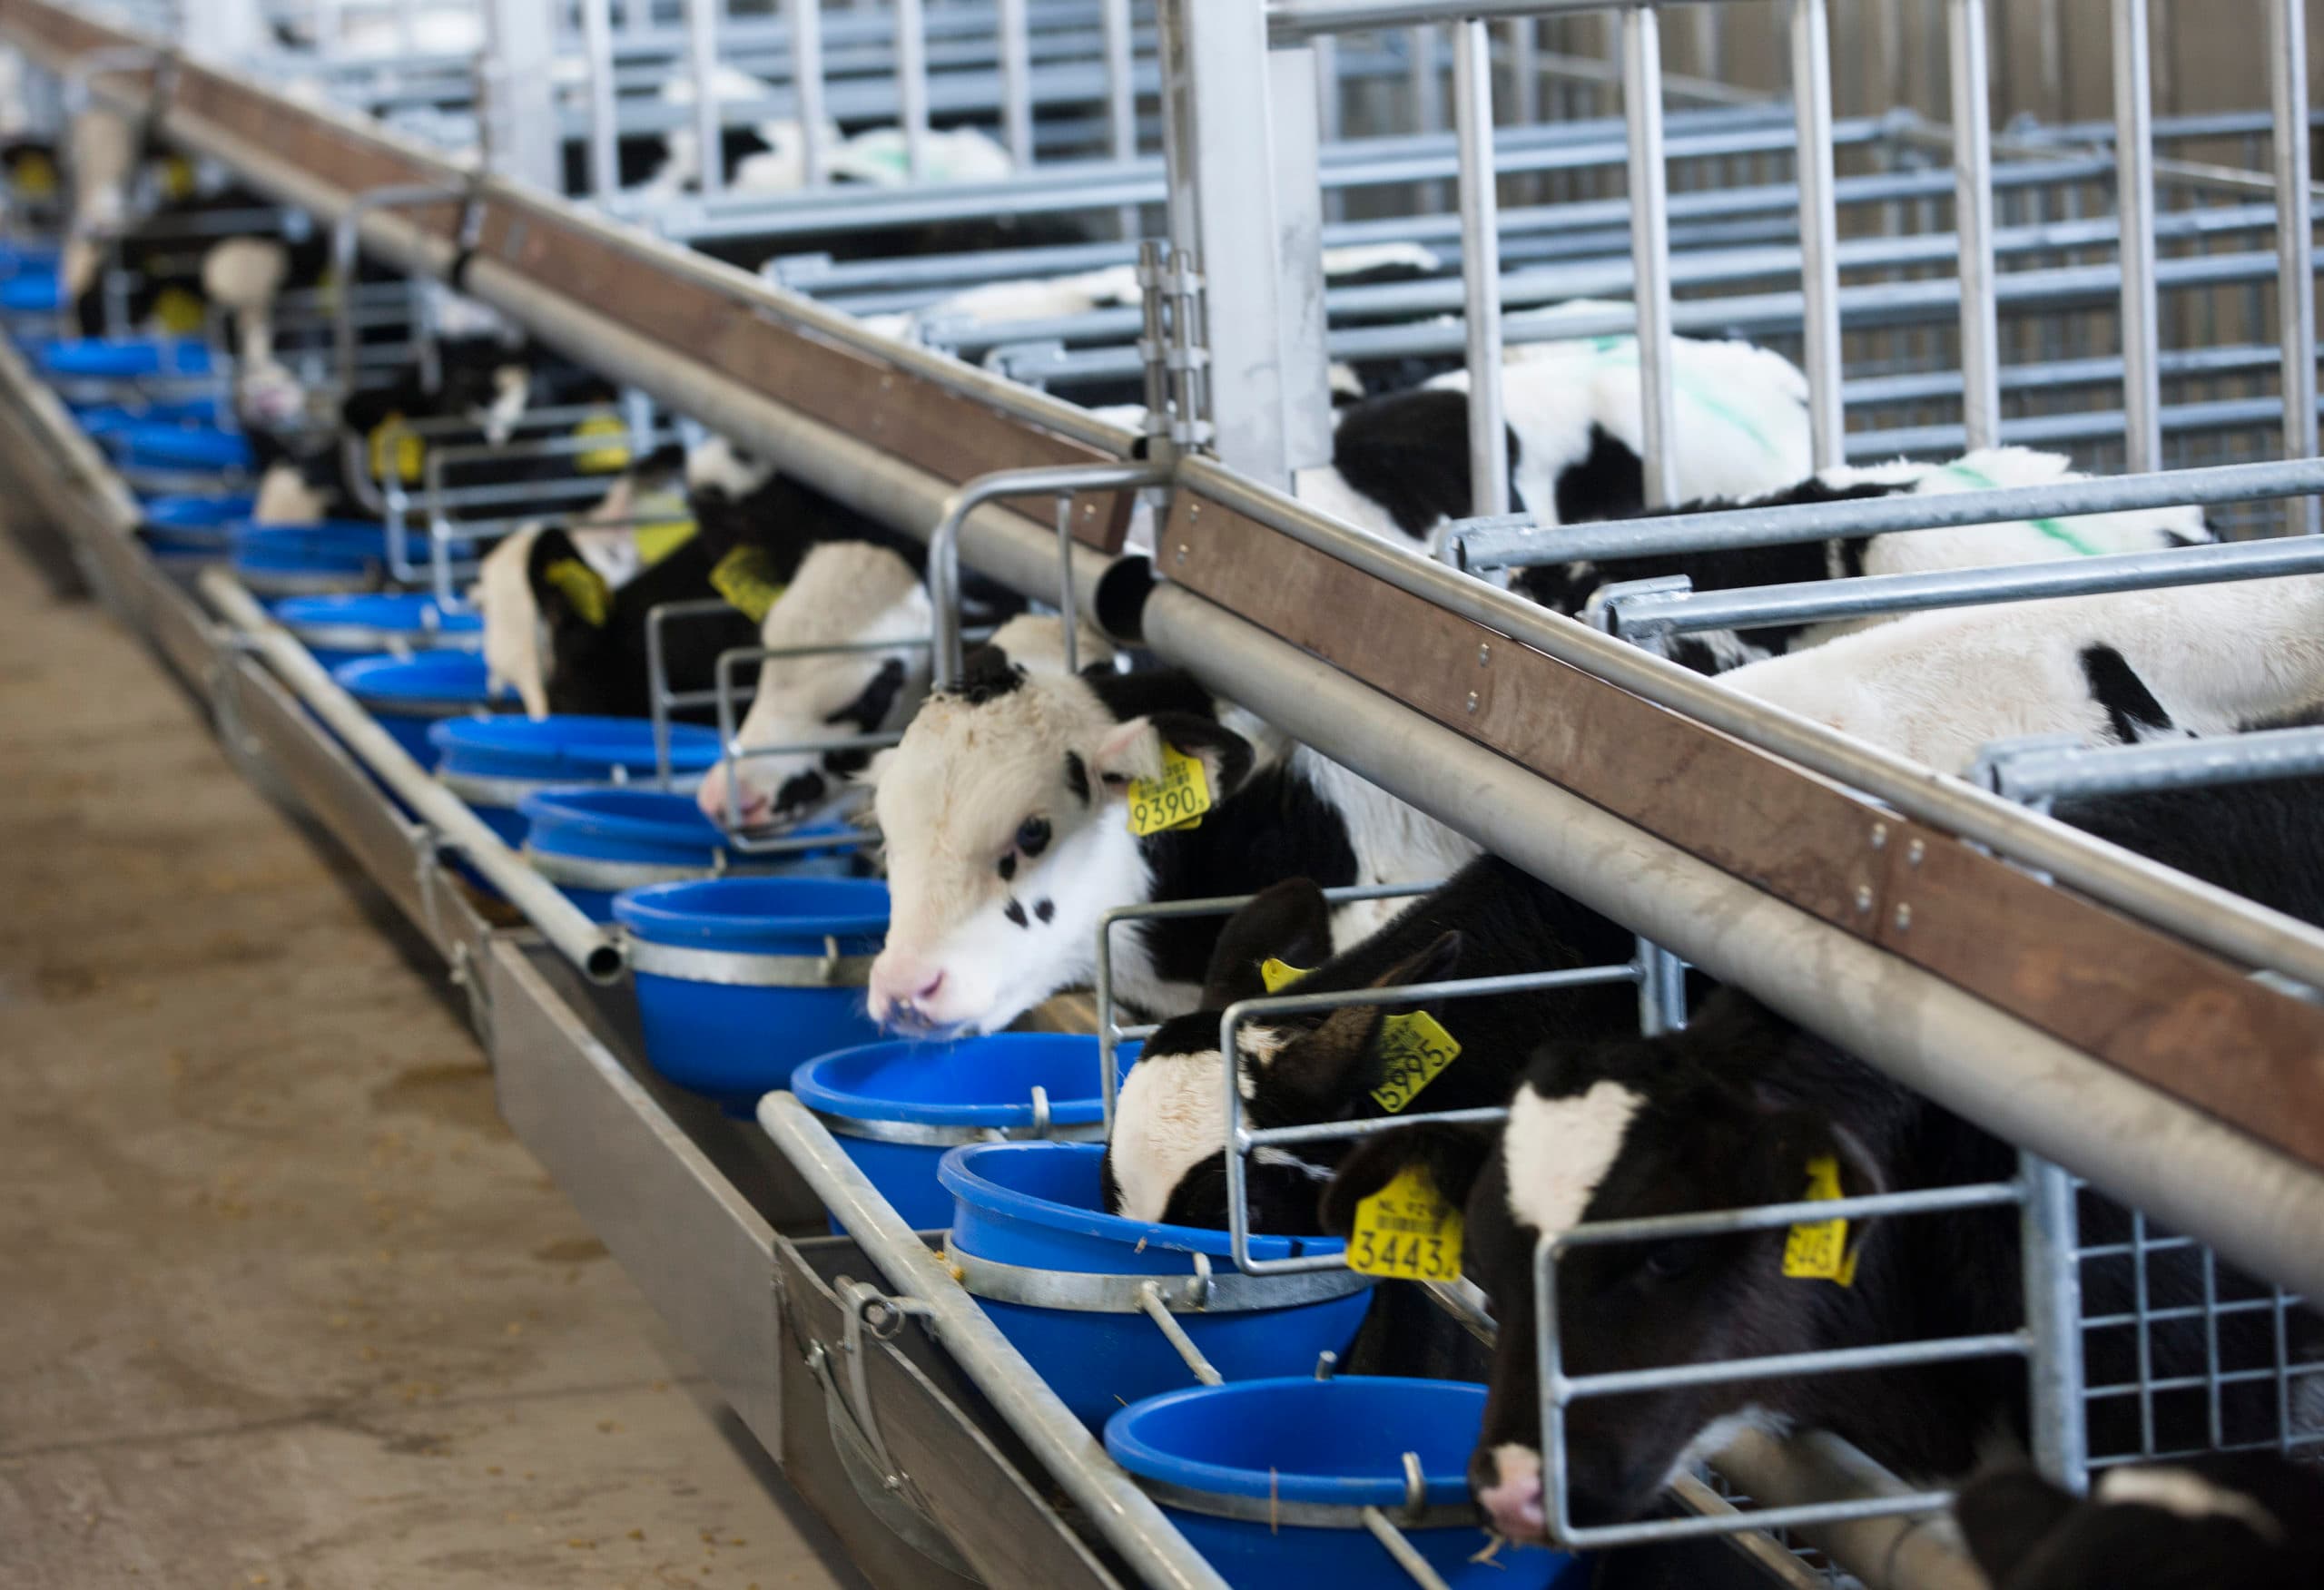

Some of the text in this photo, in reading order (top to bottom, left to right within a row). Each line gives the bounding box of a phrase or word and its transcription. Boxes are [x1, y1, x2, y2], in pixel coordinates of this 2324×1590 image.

[1134, 786, 1196, 832] 9390
[1374, 1039, 1445, 1109] 5995
[1356, 1231, 1443, 1277] 3443
